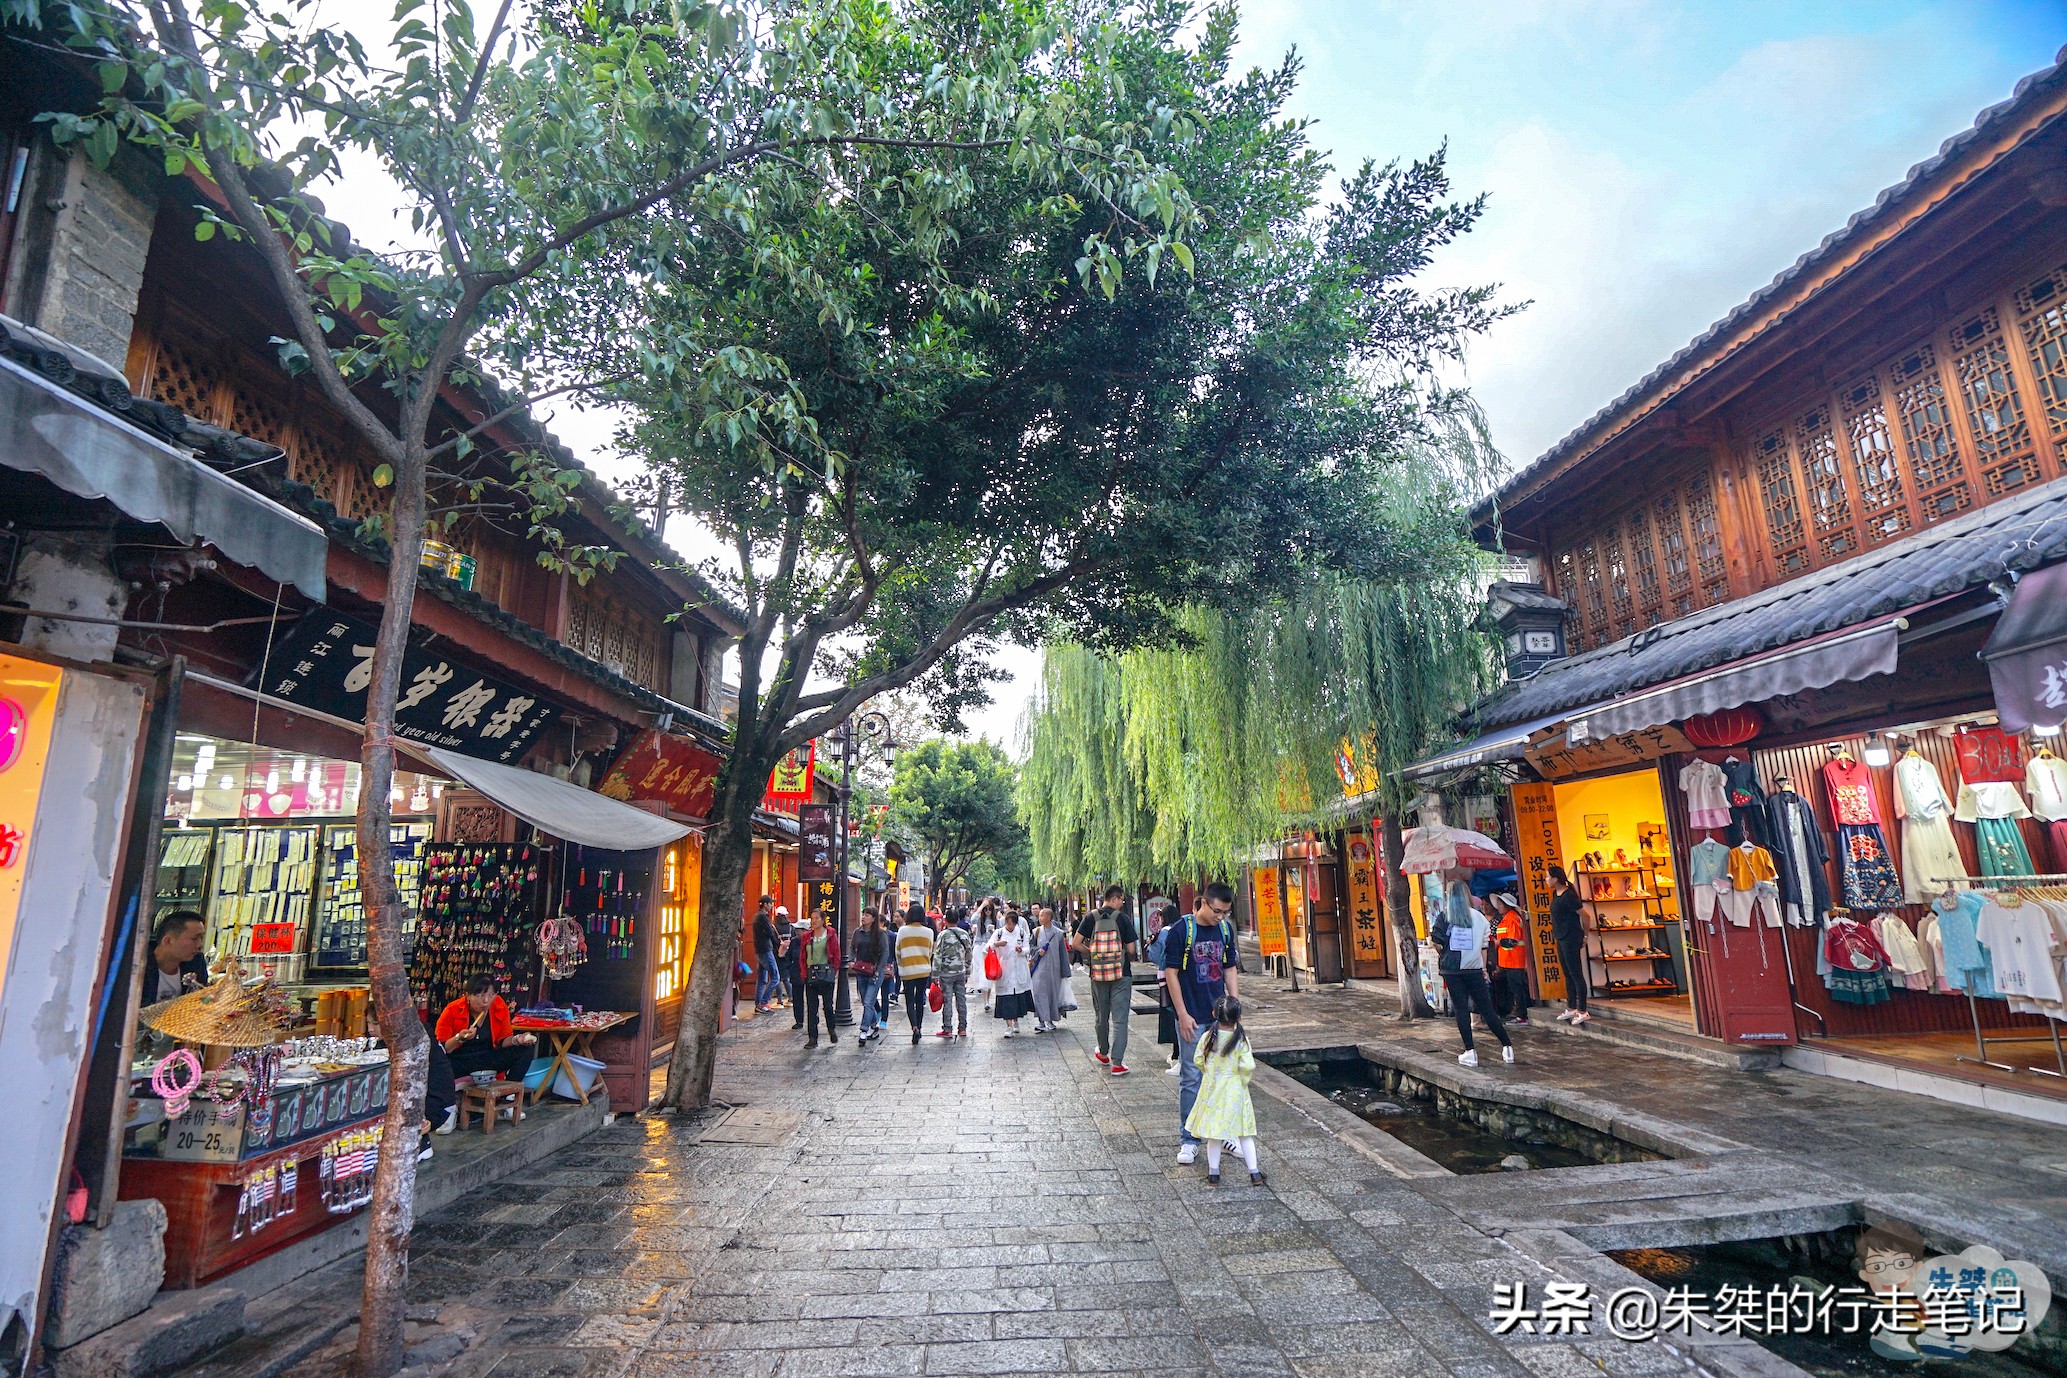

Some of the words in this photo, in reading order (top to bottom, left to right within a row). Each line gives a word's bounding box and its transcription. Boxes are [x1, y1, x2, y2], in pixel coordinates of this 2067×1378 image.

[275, 622, 350, 696] 丽江连锁
[343, 643, 535, 738] 百岁银器
[401, 726, 426, 738] year
[424, 731, 443, 742] old
[439, 734, 463, 747] silver
[500, 708, 551, 761] 寸家老字号
[1520, 804, 1555, 814] 09:00-22:00
[1523, 795, 1548, 805] 营业时间
[256, 926, 291, 939] 保健杯
[1354, 868, 1378, 951] 霸王茶姬
[1529, 856, 1560, 983] 设计师原创品牌
